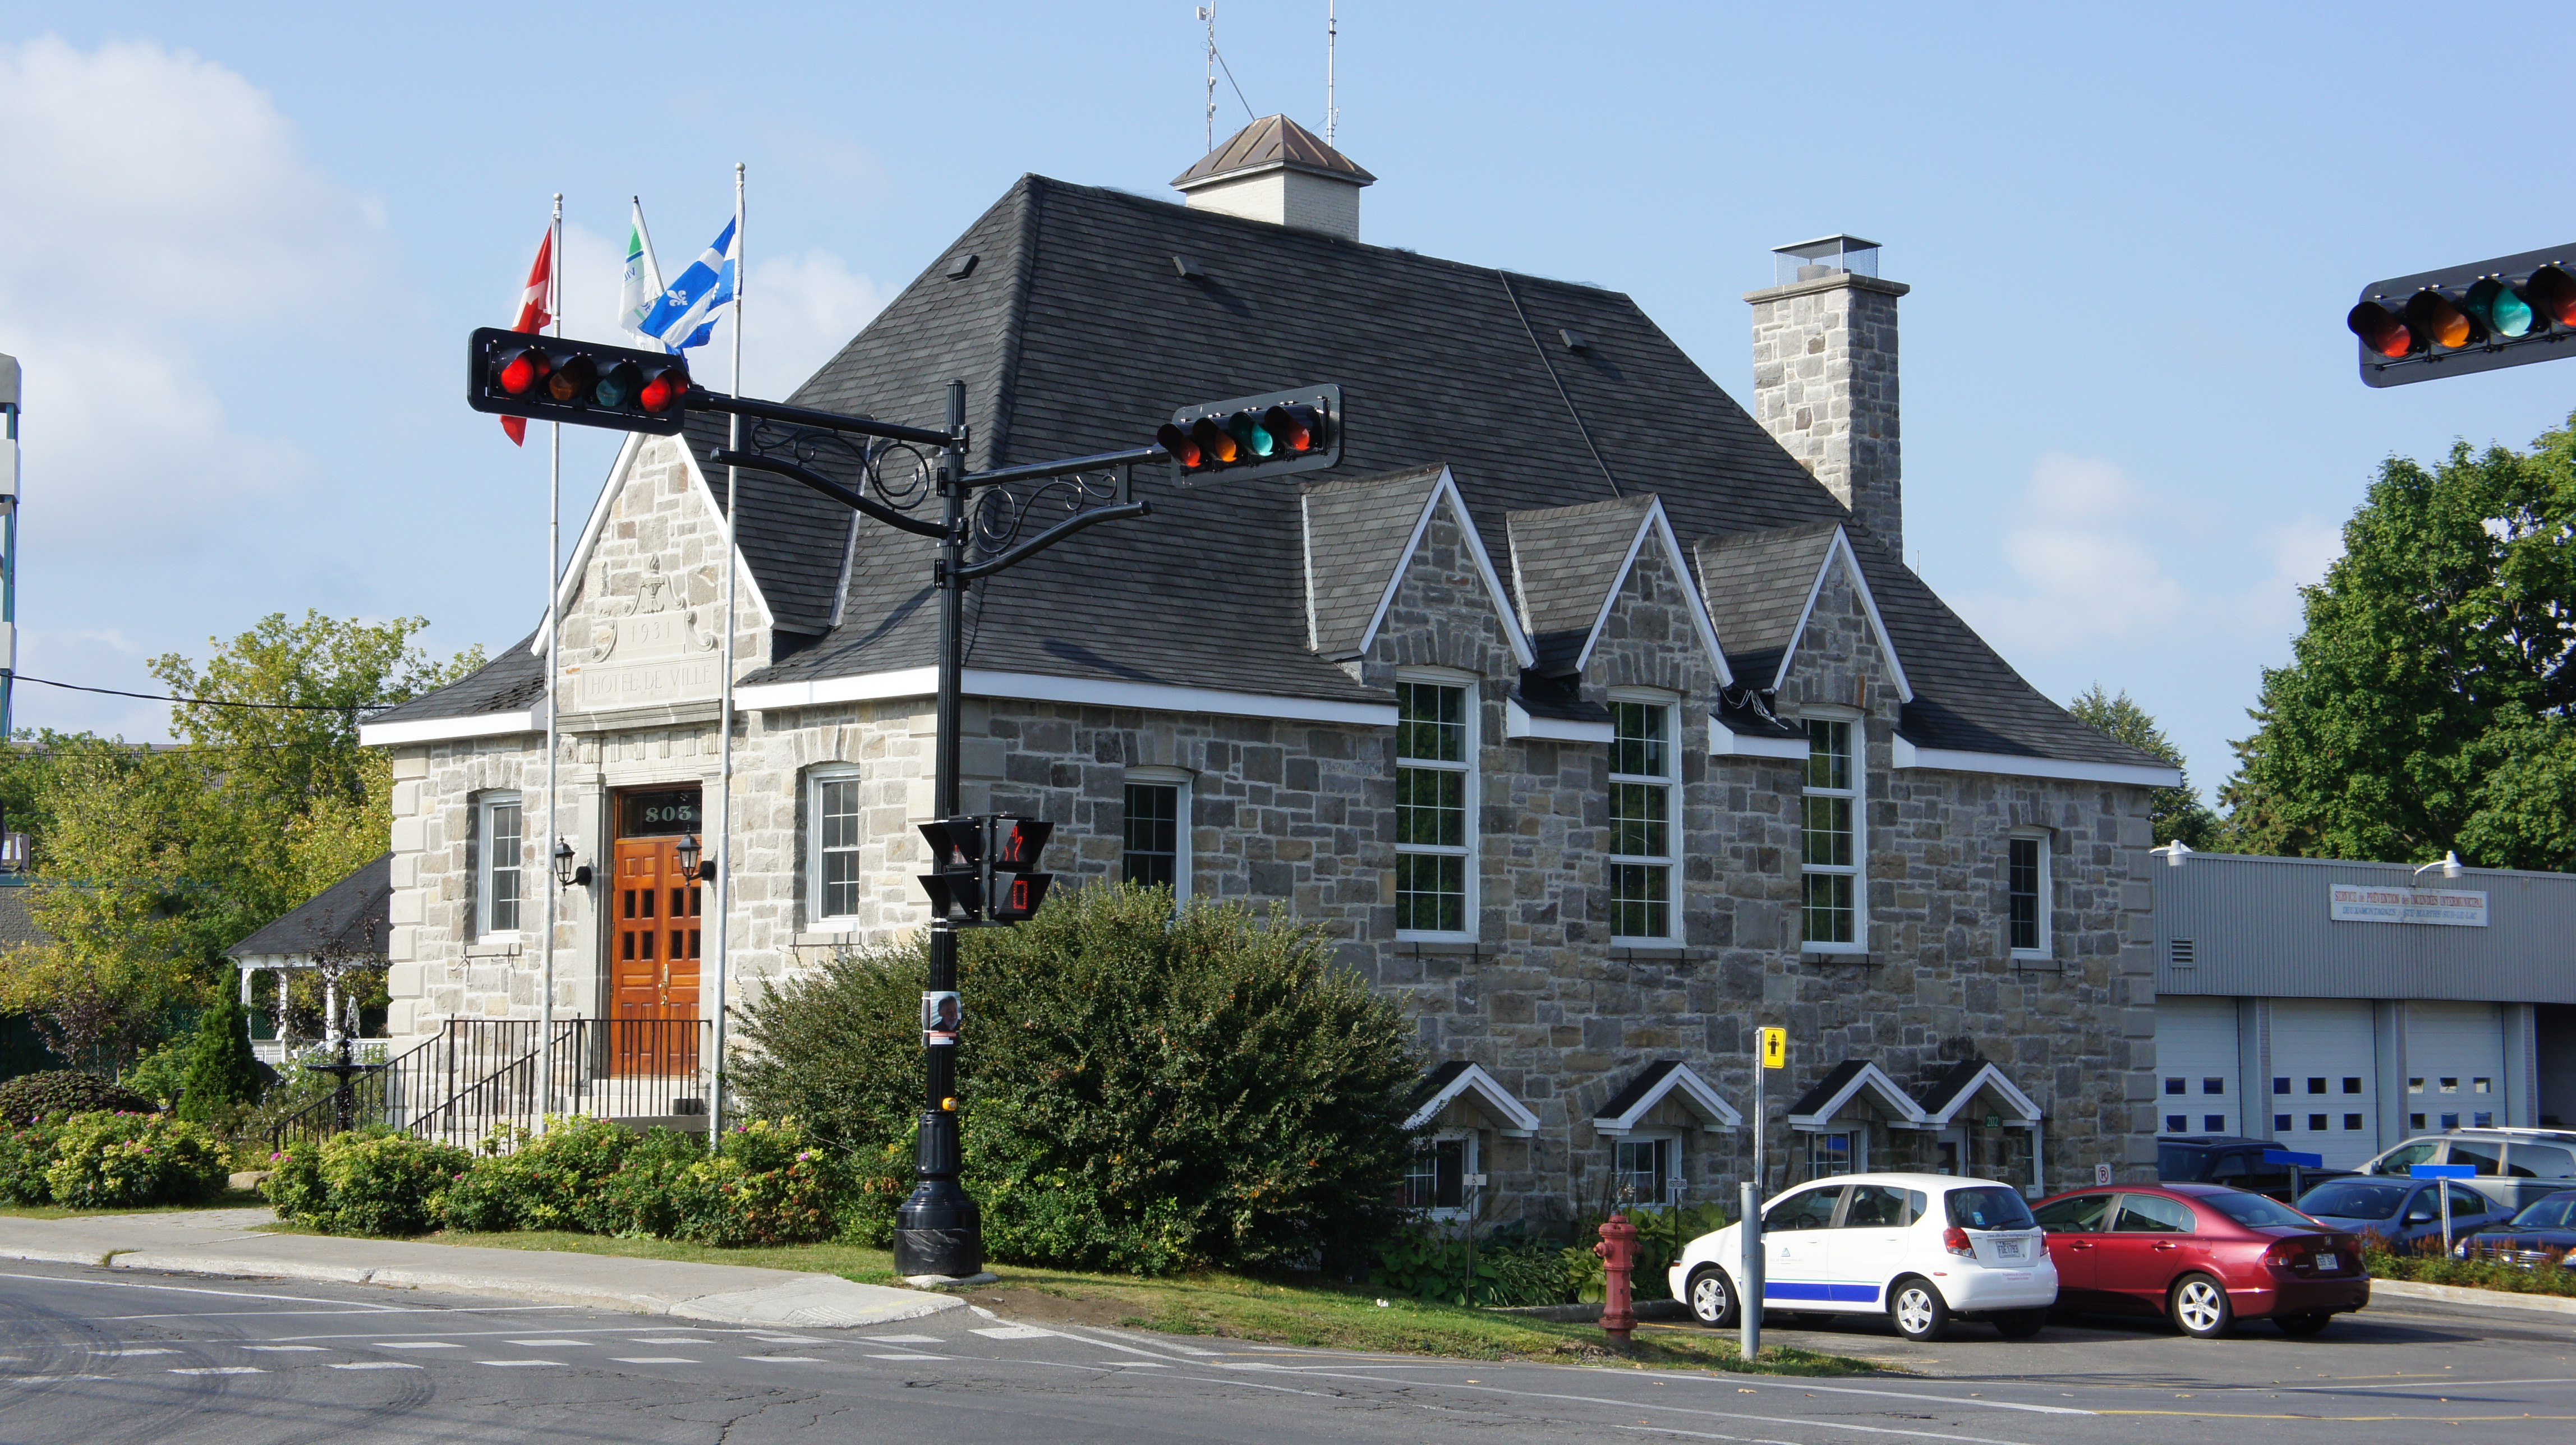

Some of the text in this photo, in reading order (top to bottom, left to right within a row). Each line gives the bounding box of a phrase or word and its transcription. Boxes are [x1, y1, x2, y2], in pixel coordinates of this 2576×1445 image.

[632, 621, 670, 643] 1931
[591, 665, 711, 694] HOTEL DE VILLE
[646, 806, 692, 822] 803
[2335, 891, 2357, 902] SERVICE
[2359, 893, 2365, 902] de
[2367, 892, 2400, 904] PRÉVENTION
[2411, 895, 2438, 905] INCENDIES
[2440, 896, 2483, 908] INTERMUNICIPAL
